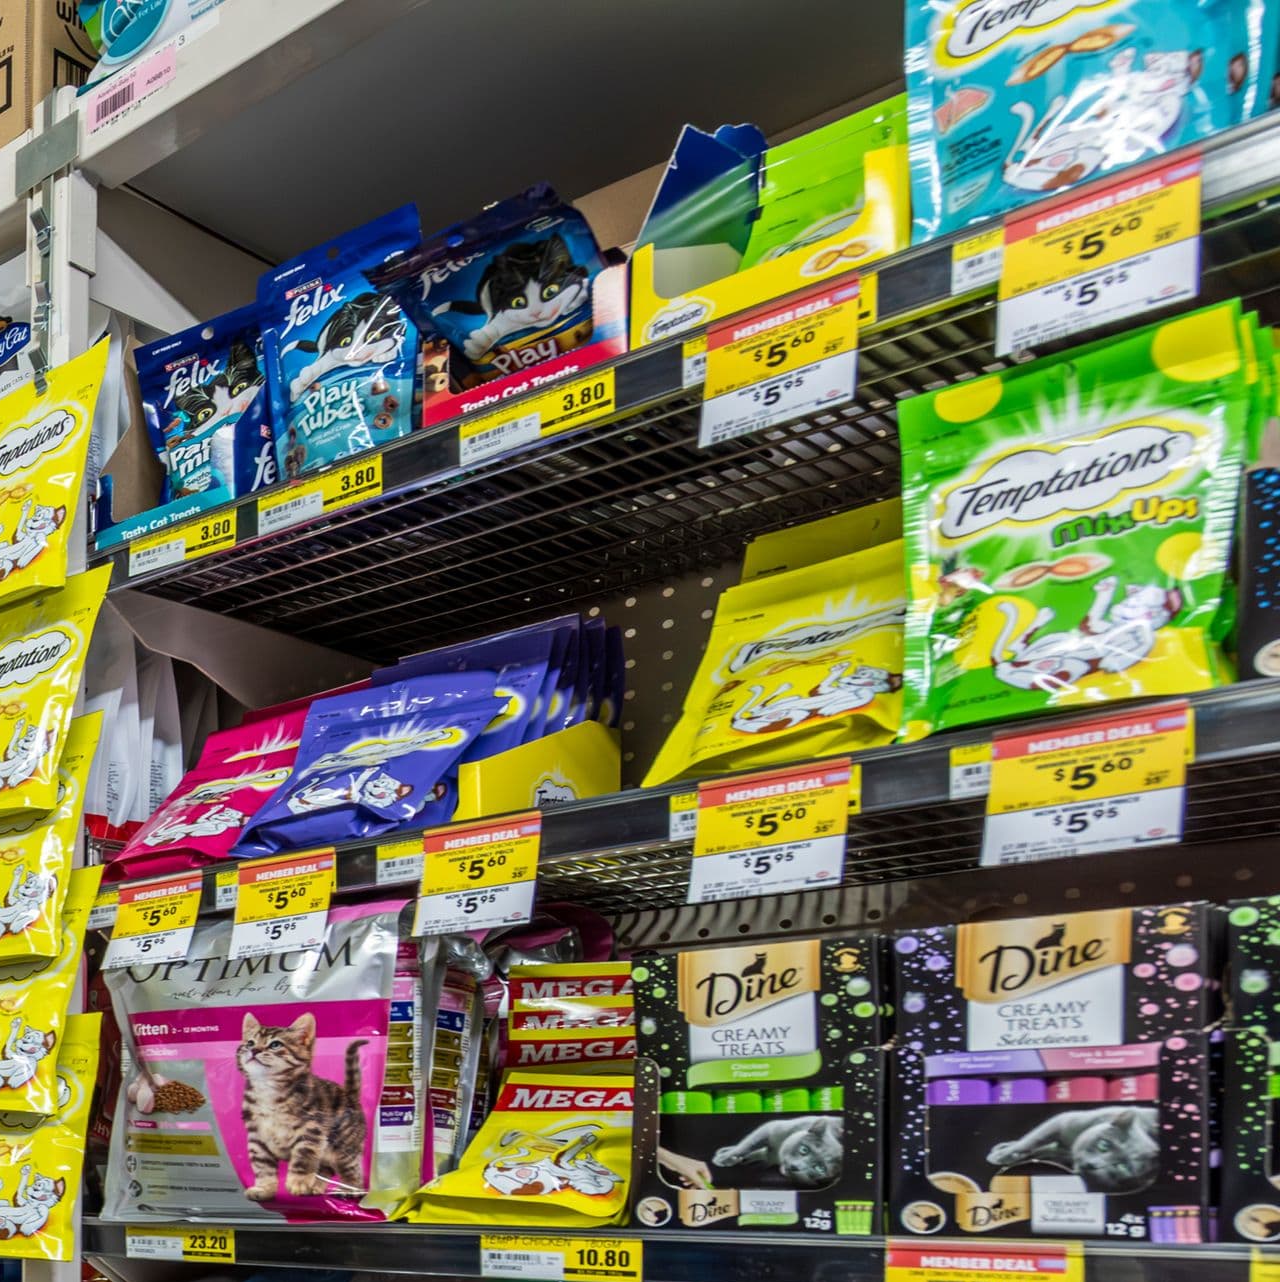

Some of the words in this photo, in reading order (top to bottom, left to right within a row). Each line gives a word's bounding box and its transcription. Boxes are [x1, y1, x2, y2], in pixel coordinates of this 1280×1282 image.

[1036, 197, 1113, 232] MEMBER
[281, 284, 344, 339] felix
[734, 311, 794, 340] MEMBER
[795, 299, 832, 318] DEAL
[492, 339, 557, 375] Play
[163, 359, 221, 409] felix
[305, 379, 358, 413] Play
[563, 382, 604, 412] 3.80
[298, 400, 364, 436] Tubes
[341, 467, 375, 491] 3.80
[955, 432, 1178, 528] Temptations
[121, 525, 147, 540] Tasty
[150, 517, 168, 529] Cat
[201, 519, 230, 540] 3.80
[1028, 731, 1104, 753] MEMBER
[1107, 723, 1154, 740] DEAL
[726, 782, 785, 803] MEMBER
[787, 774, 823, 793] DEAL
[445, 834, 490, 849] MEMBER
[492, 829, 521, 842] DEAL
[256, 868, 294, 881] MEMBER
[295, 864, 317, 874] DEAL
[134, 887, 170, 901] MEMBER
[171, 885, 188, 894] DEAL
[979, 937, 1107, 993] Dine
[697, 968, 798, 1018] Dine
[997, 1001, 1090, 1018] CREAMY
[711, 1027, 791, 1041] CREAMY
[1006, 1016, 1083, 1031] TREATS
[720, 1041, 785, 1056] TREATS
[997, 1032, 1088, 1045] Selections
[509, 1089, 633, 1108] MEGA
[690, 1200, 731, 1222] Dine
[969, 1206, 1021, 1226] Dine
[804, 1218, 831, 1231] 12g
[190, 1236, 227, 1250] 23.20
[577, 1250, 629, 1267] 10.80
[920, 1256, 991, 1269] MEMBER
[993, 1259, 1037, 1271] DEAL
